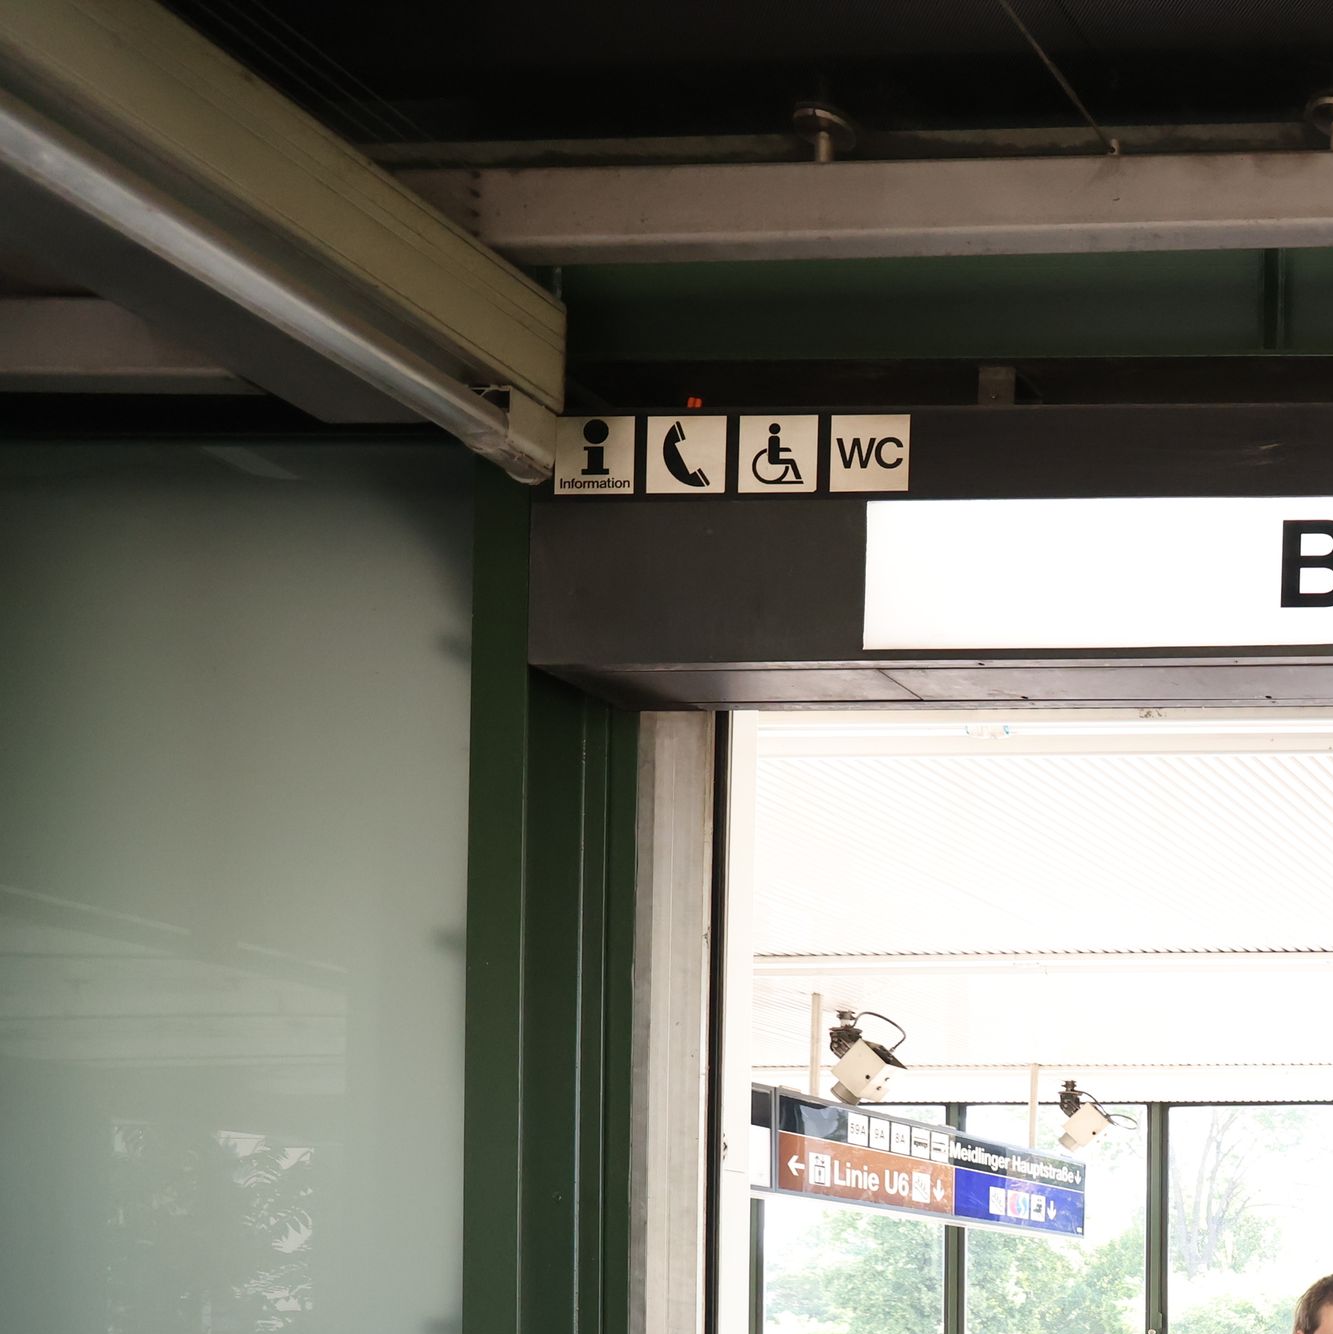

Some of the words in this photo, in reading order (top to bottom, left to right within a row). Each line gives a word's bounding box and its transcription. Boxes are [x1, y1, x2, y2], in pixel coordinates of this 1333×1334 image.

[836, 437, 904, 469] WC
[560, 478, 631, 489] Information
[850, 1122, 866, 1135] 59A
[874, 1128, 885, 1139] 9A
[949, 1140, 1010, 1172] Meidlinger
[1012, 1154, 1075, 1183] Hauptstraße
[834, 1159, 880, 1192] Linie
[884, 1169, 910, 1197] U6
